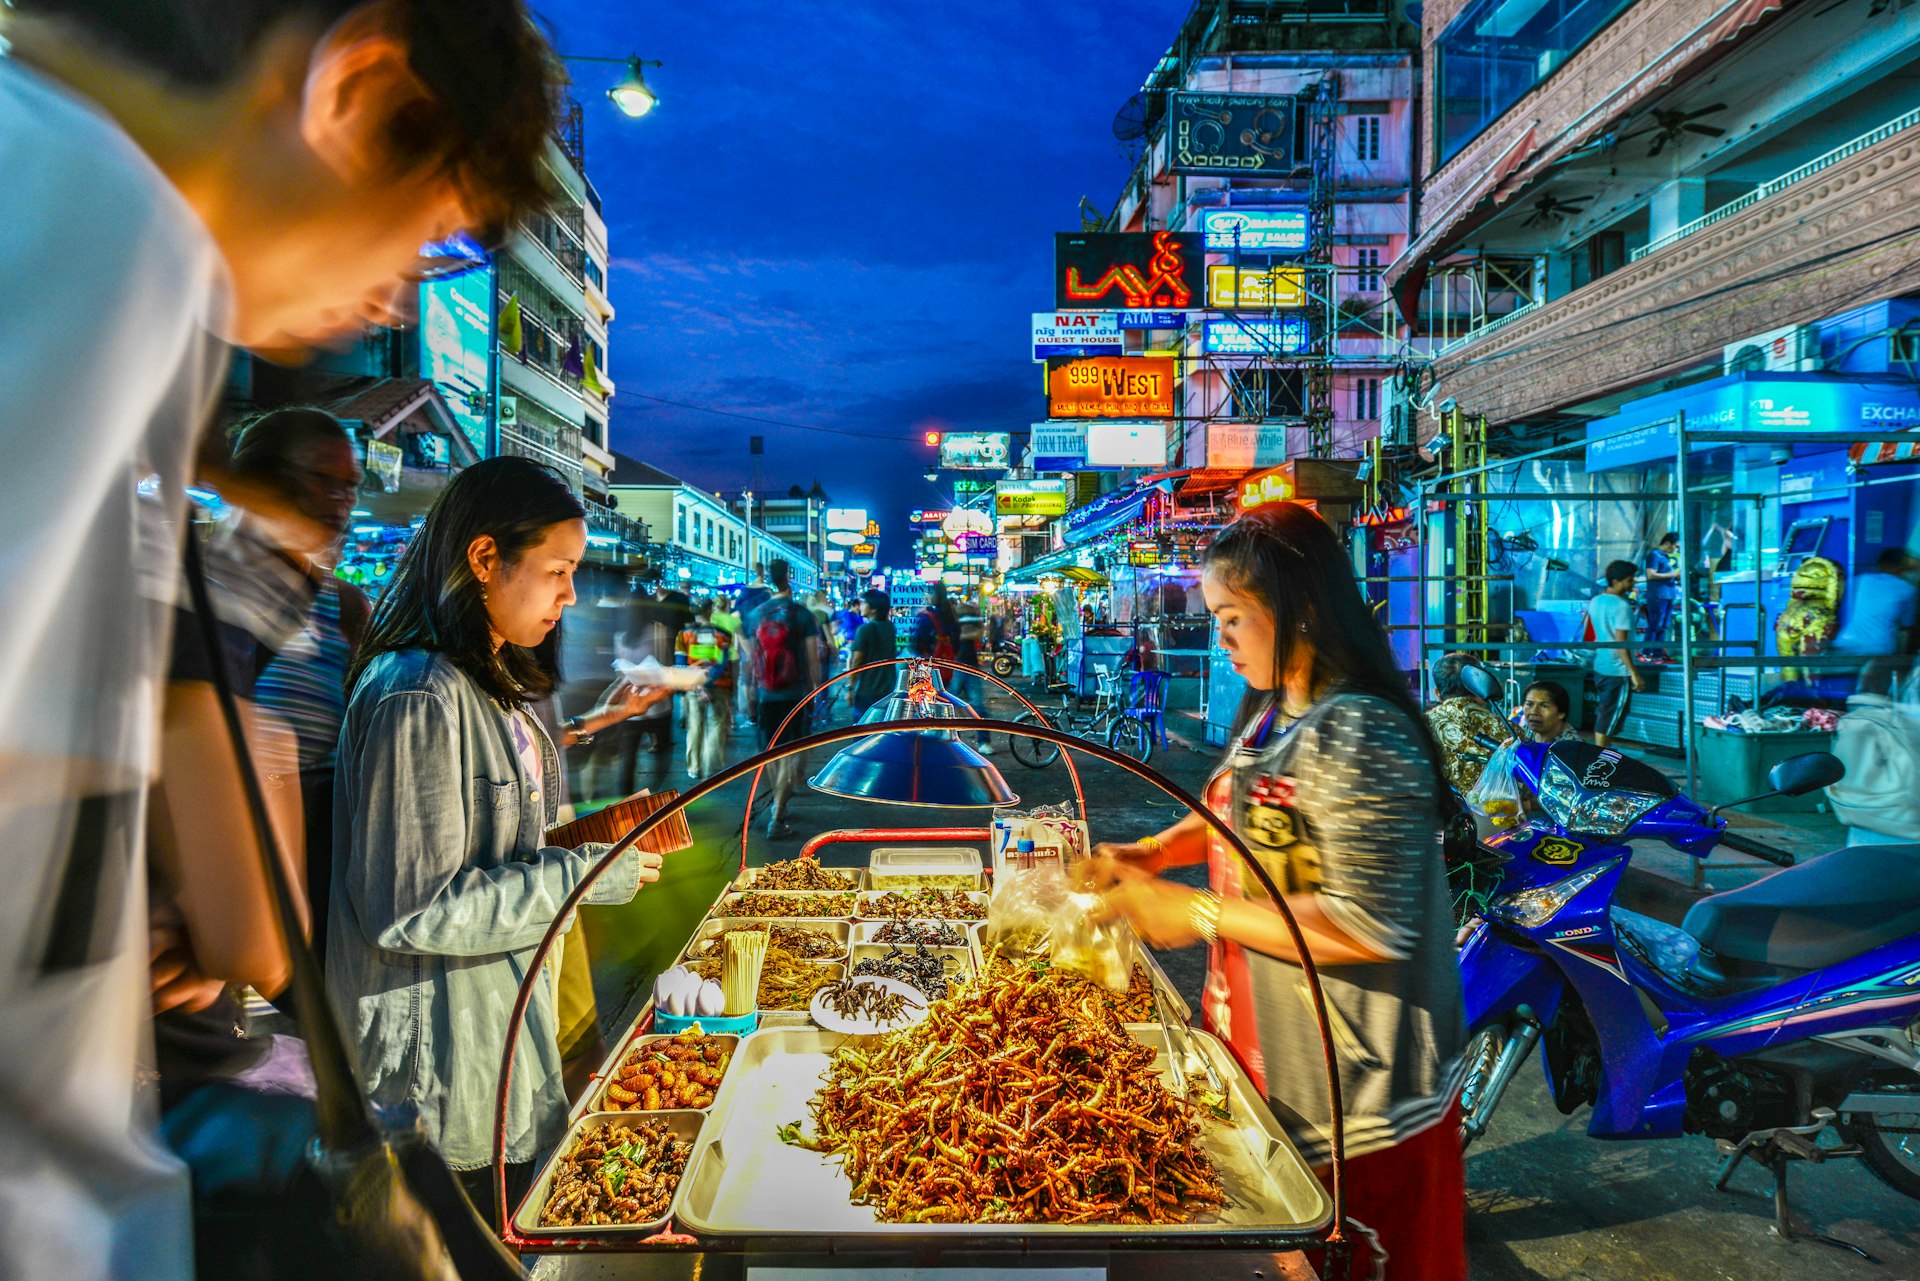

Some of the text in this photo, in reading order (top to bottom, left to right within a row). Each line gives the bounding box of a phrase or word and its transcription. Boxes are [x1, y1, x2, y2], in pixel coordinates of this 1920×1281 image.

[1055, 315, 1100, 327] NAT
[1122, 312, 1154, 324] ATM
[1037, 336, 1120, 344] GUEST HOUSE
[1070, 366, 1098, 384] 999
[1861, 406, 1920, 420] EXCHA
[1036, 435, 1056, 453] ORM
[1227, 433, 1249, 446] Blue
[1255, 433, 1283, 447] White
[1012, 495, 1036, 503] Kodak
[966, 536, 997, 550] SIM CARD
[1555, 925, 1603, 938] HONDA
